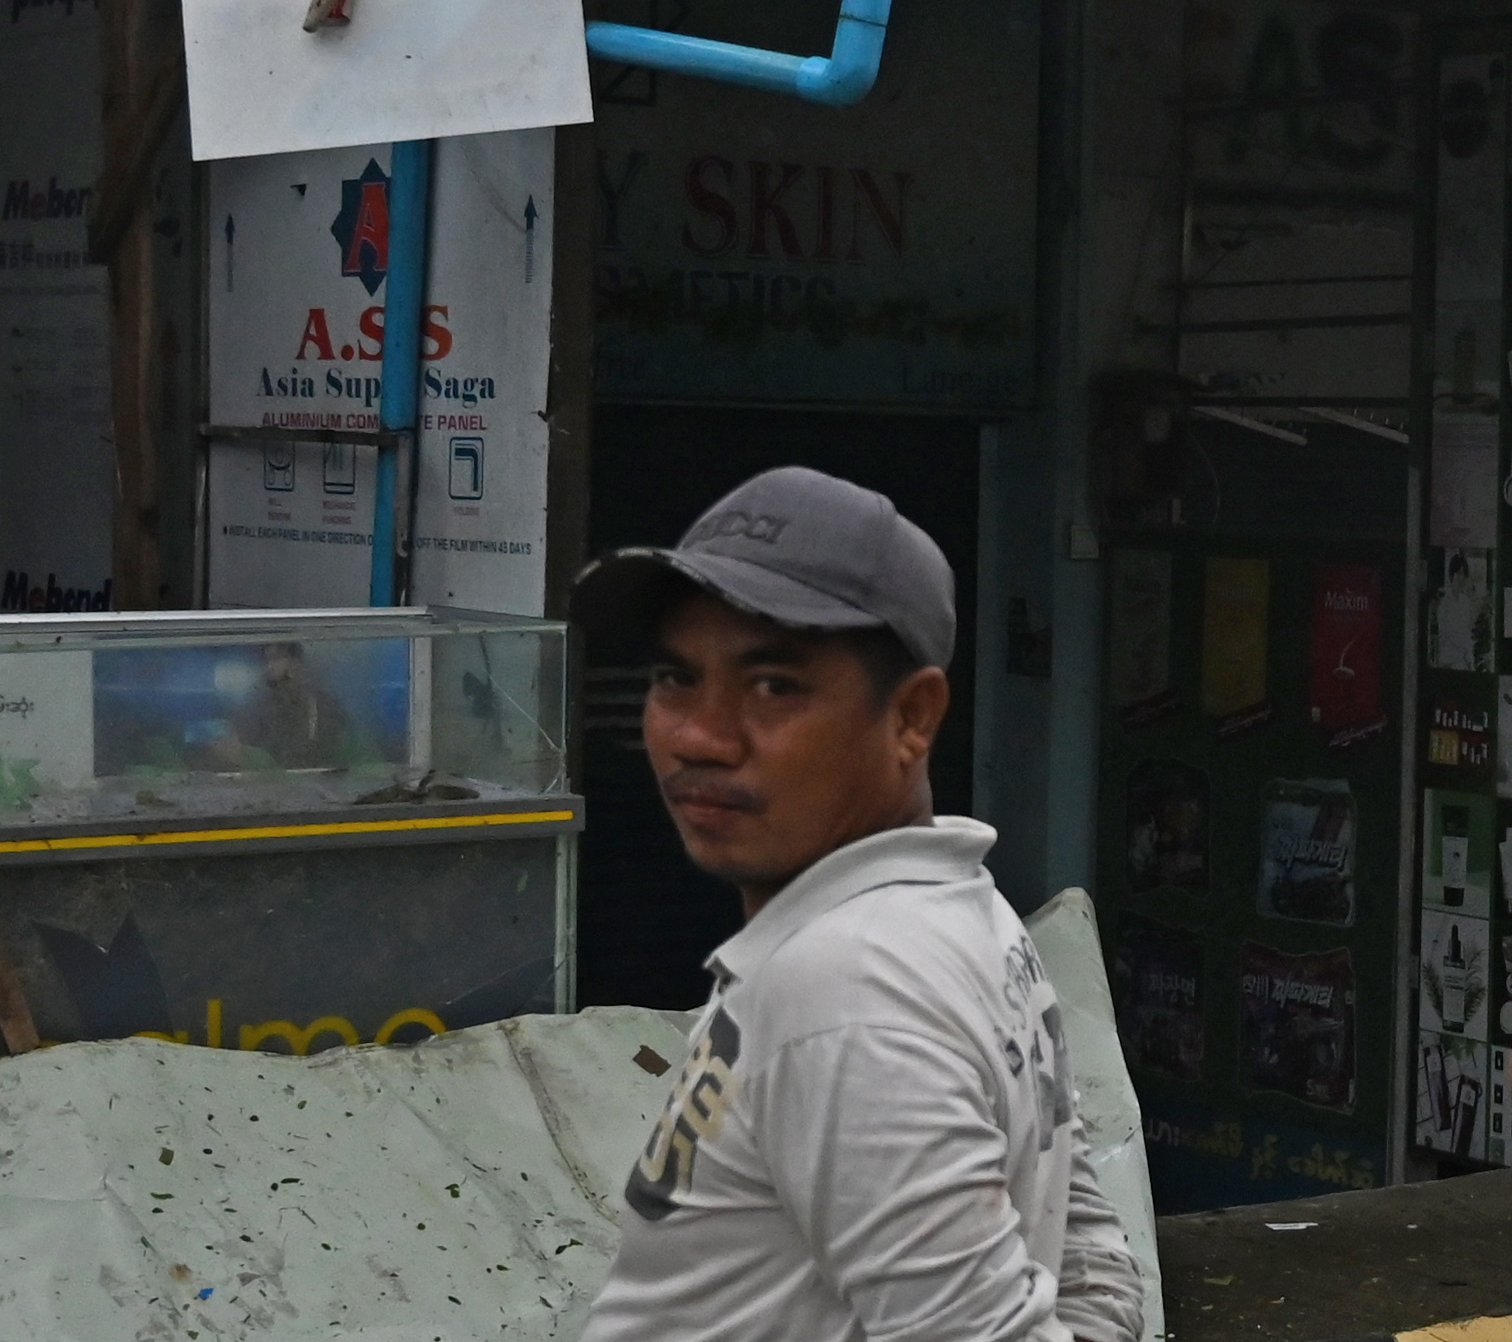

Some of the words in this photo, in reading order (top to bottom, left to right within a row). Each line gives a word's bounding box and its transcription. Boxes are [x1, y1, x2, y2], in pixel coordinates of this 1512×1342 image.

[681, 153, 918, 263] SKIN
[256, 367, 316, 399] Asia
[325, 367, 381, 408] Sup
[424, 367, 496, 409] Saga
[262, 412, 342, 429] ALUMINIUM
[437, 414, 488, 431] PANEL
[433, 538, 448, 551] THE
[509, 542, 532, 556] DAYS
[1, 570, 113, 612] Mebond
